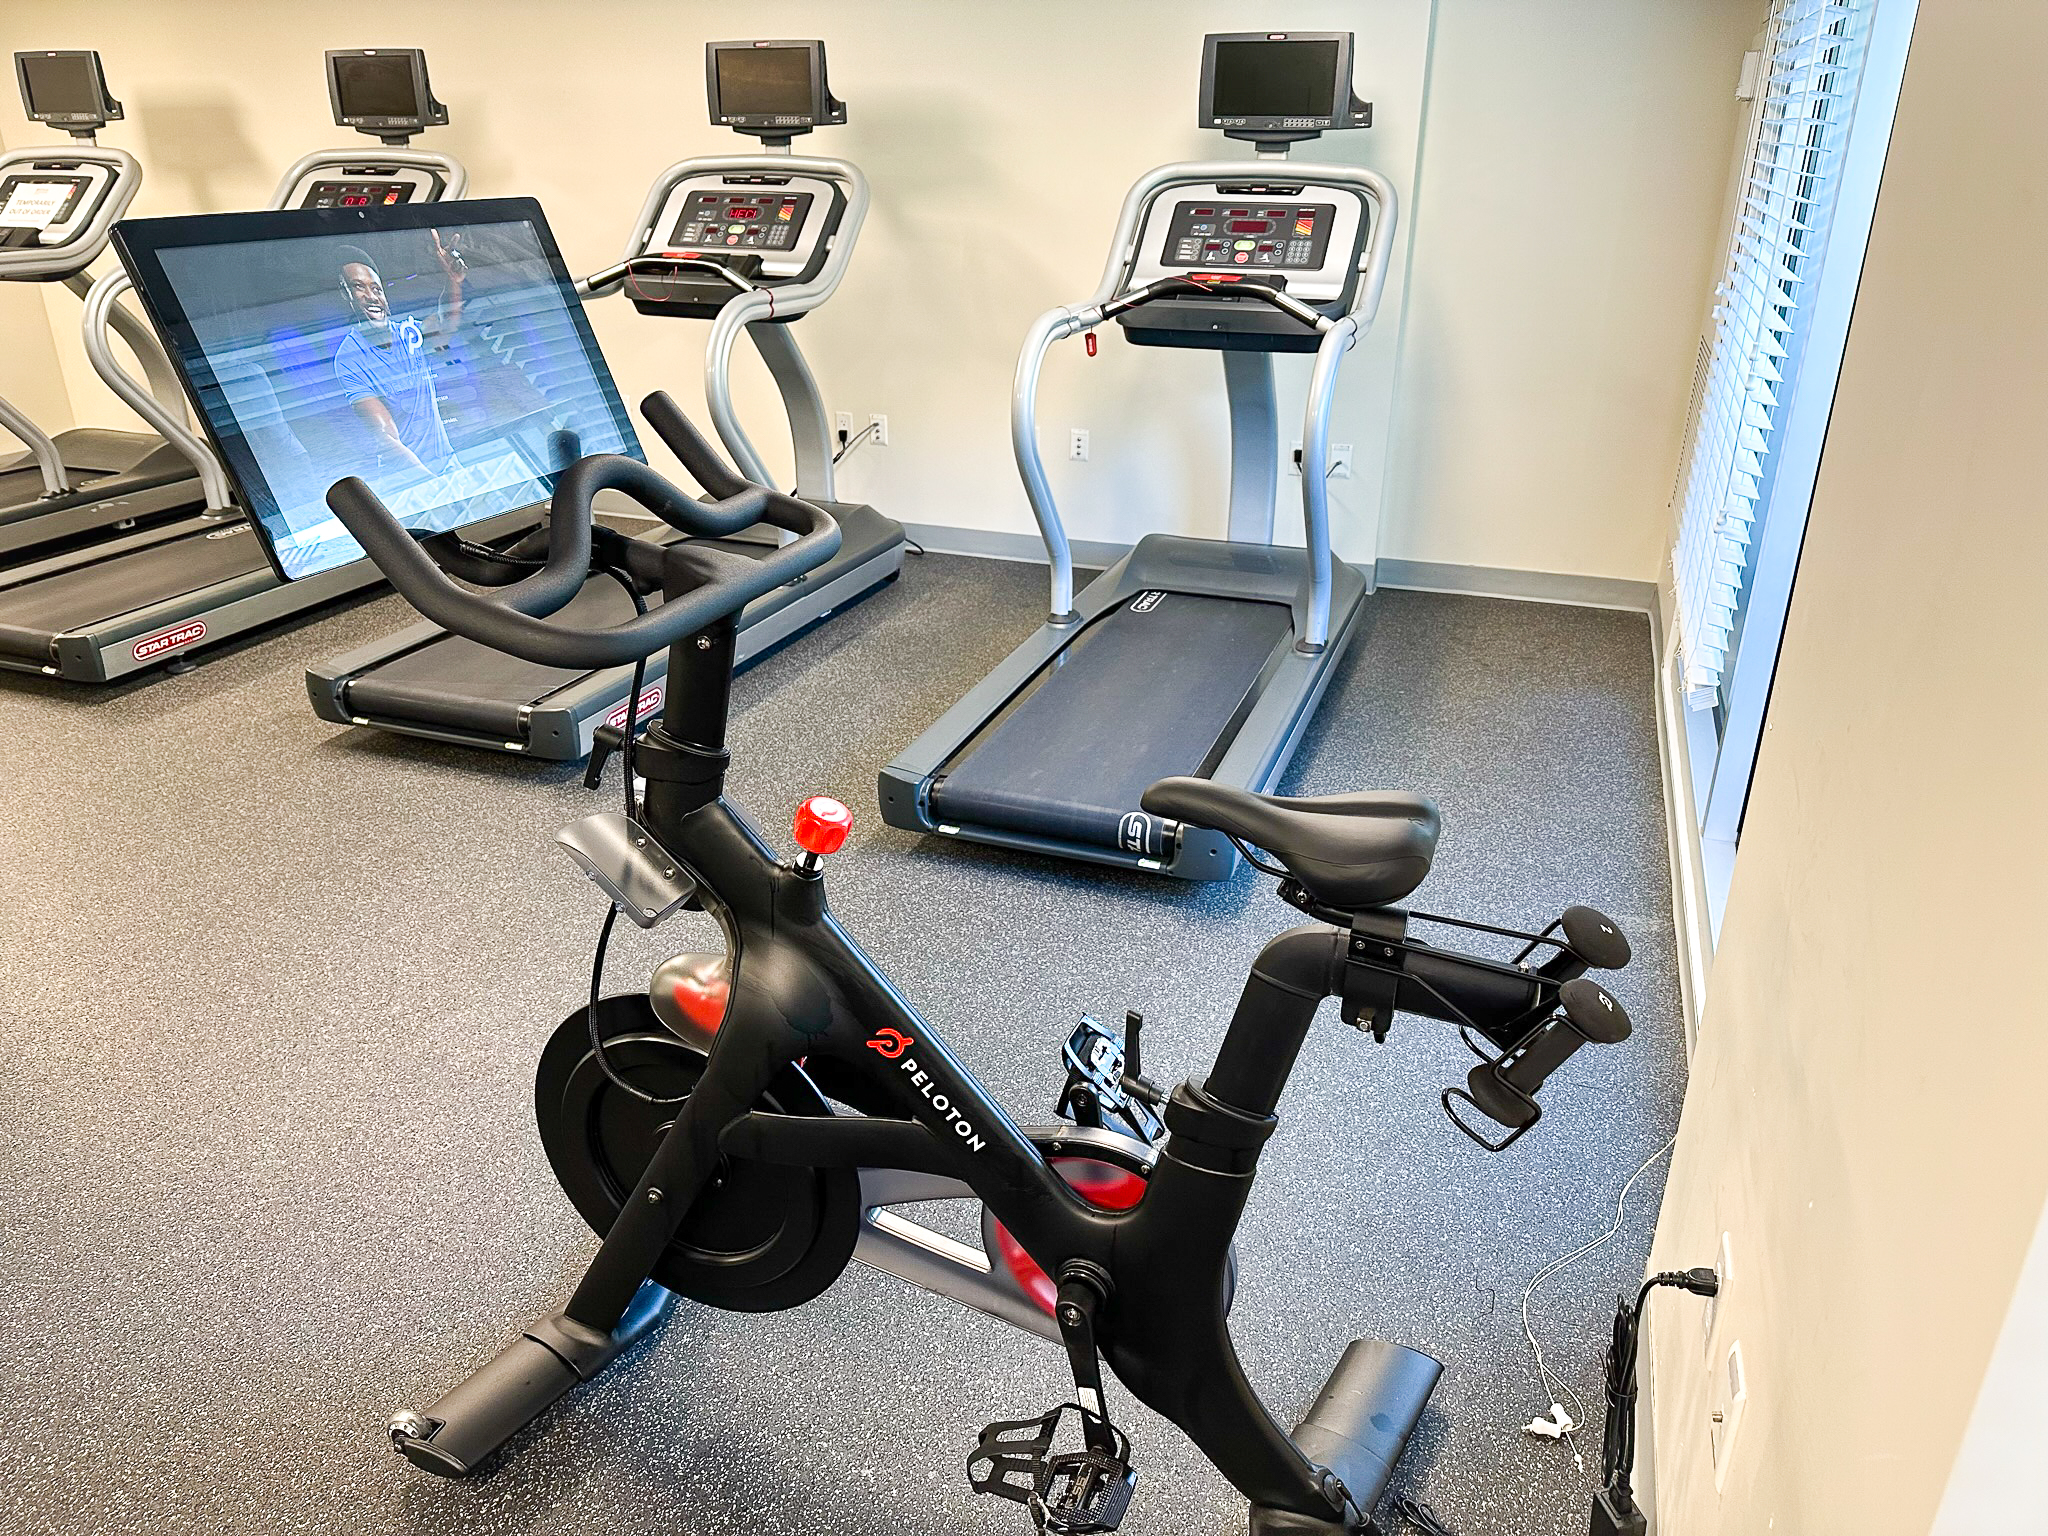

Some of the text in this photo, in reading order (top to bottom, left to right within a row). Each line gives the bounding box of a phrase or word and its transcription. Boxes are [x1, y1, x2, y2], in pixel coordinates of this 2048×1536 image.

[138, 626, 201, 655] STAR TRAC
[637, 693, 660, 713] RAC
[900, 1058, 986, 1152] PELOTON
